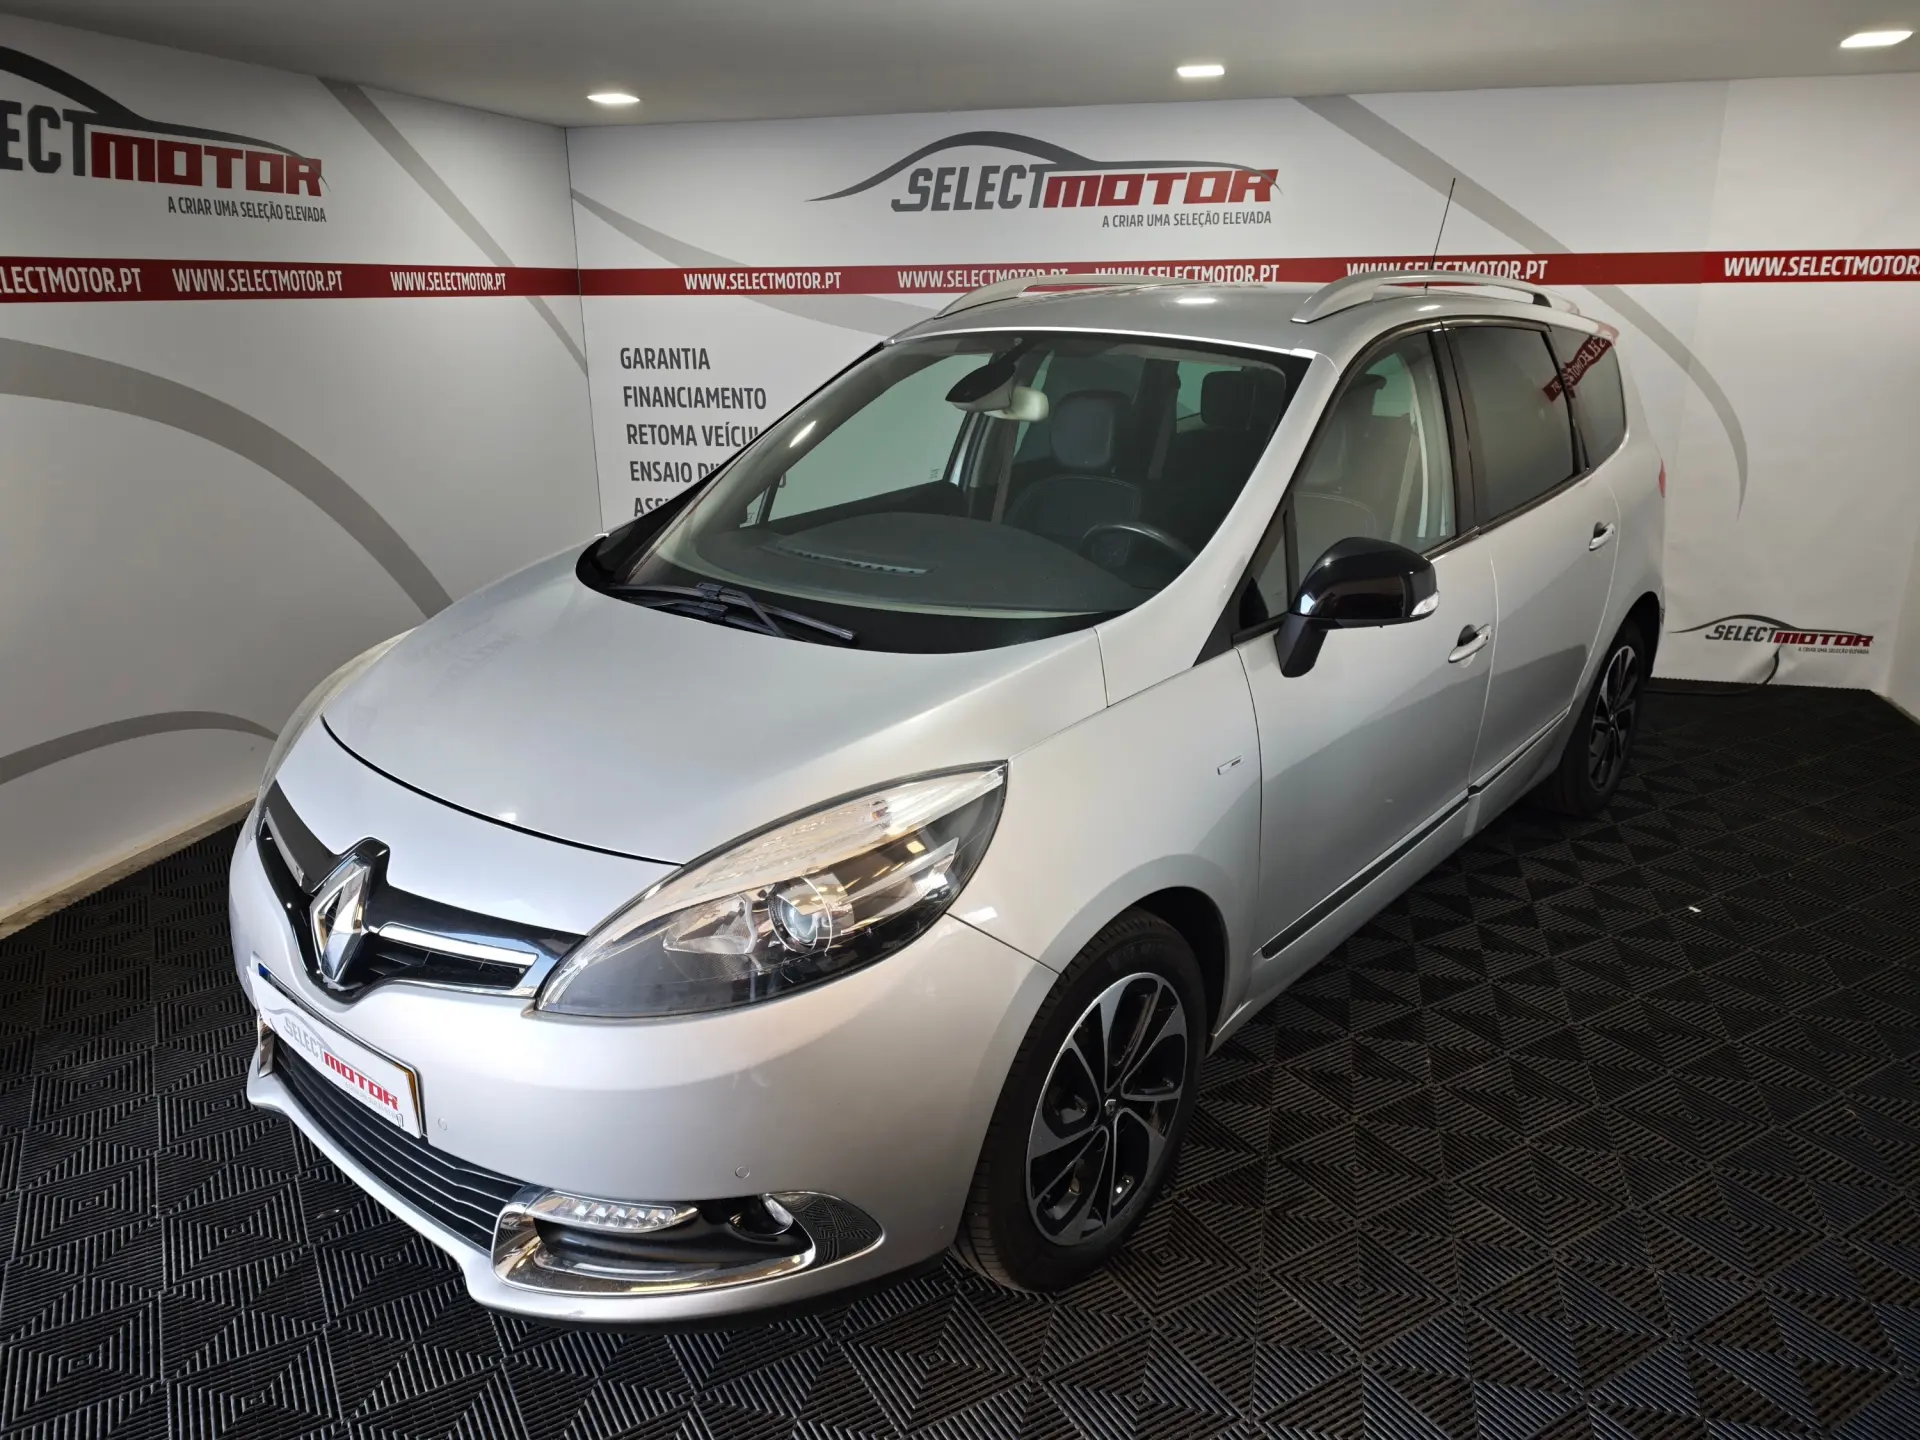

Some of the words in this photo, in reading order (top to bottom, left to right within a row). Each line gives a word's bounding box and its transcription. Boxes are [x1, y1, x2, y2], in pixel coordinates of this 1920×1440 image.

[168, 196, 177, 214] A
[178, 197, 212, 216] CRIAR
[214, 200, 239, 218] UMA
[241, 201, 283, 223] SELEÇÃO
[285, 205, 327, 223] ELEVADA
[1102, 215, 1110, 228] A
[1112, 214, 1144, 228] CRIAR
[1147, 213, 1171, 227] UMA
[1173, 211, 1220, 229] SELEÇÃO
[1223, 211, 1272, 225] ELEVADA
[0, 265, 142, 294] LECTMOTOR.PT
[172, 268, 343, 293] WWW.SELECTMOTOR.PT
[390, 271, 506, 291] WWW.SELECTMOTOR.PT
[683, 271, 842, 290] WWW.SELECTMOTOR.PT
[897, 268, 1069, 288] WWW.SELECTMOT
[620, 347, 711, 370] GARANTIA
[623, 385, 767, 410] FINANCIAMENTO
[626, 424, 698, 447] RETOMA
[629, 461, 693, 483] ENSAIO
